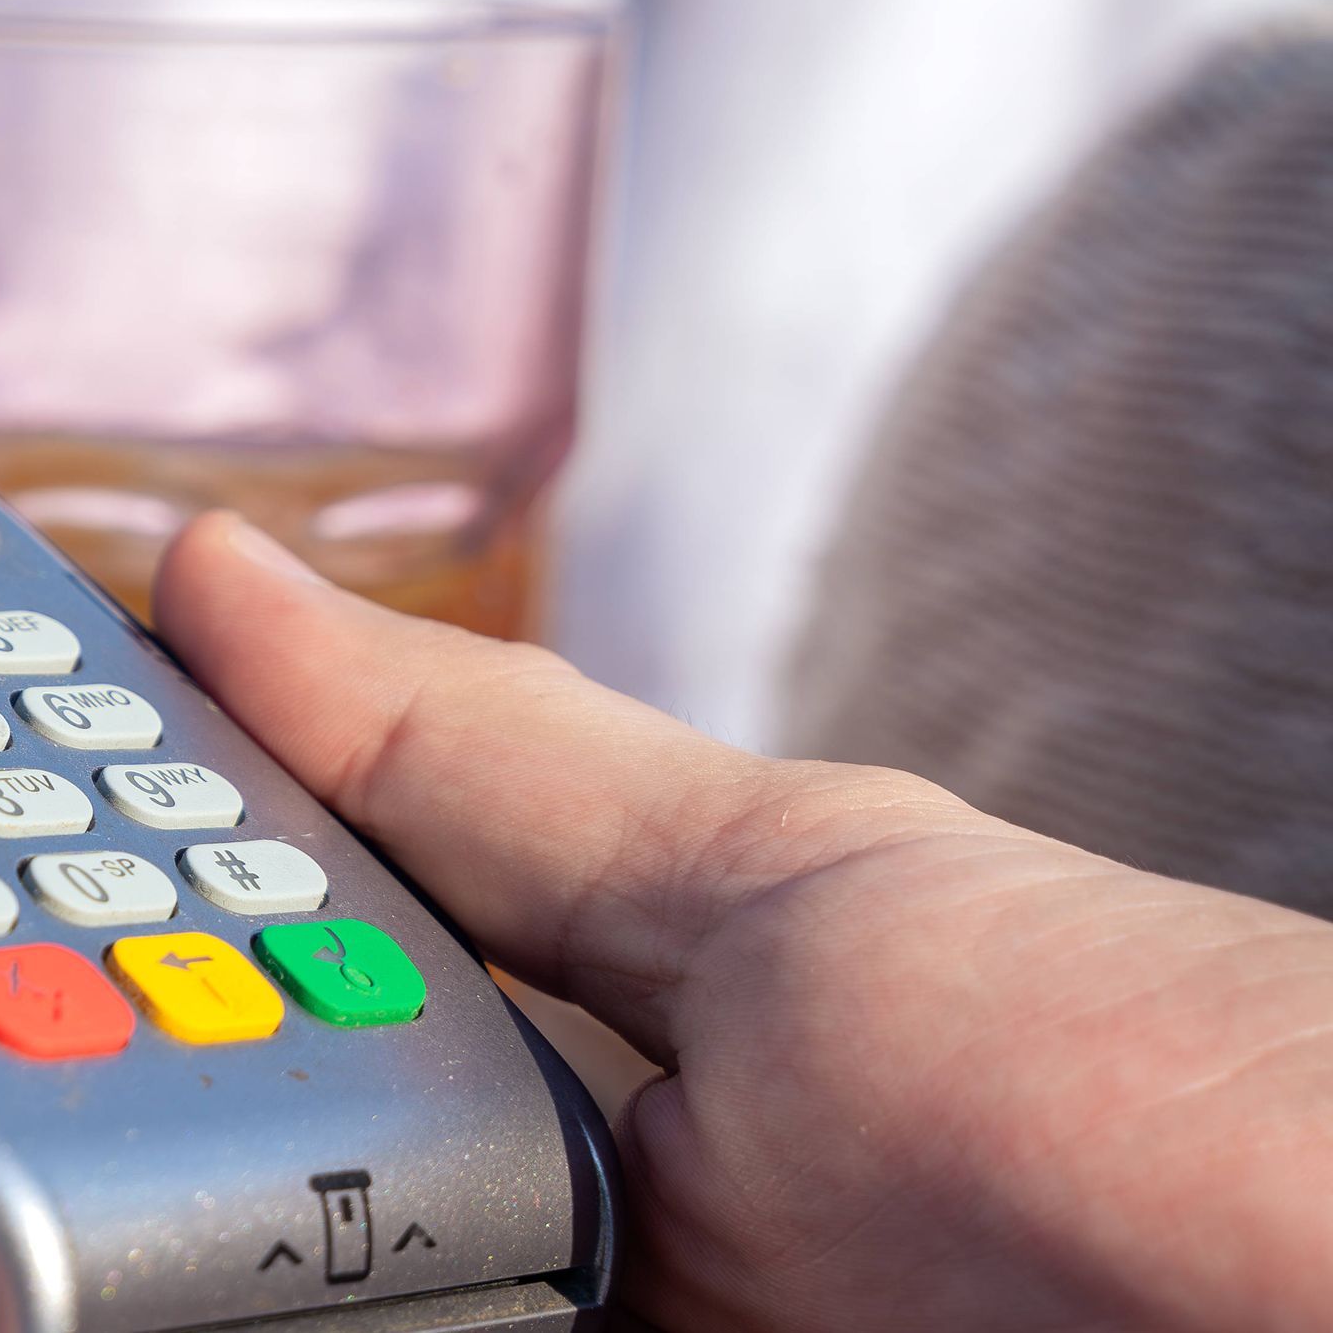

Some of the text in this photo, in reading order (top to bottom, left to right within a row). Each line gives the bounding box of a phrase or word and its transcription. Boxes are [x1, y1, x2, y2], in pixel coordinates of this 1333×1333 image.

[42, 690, 131, 730] 6 MNO
[0, 774, 55, 794] TUV
[125, 767, 209, 808] 9 WXY
[58, 863, 109, 902] 0
